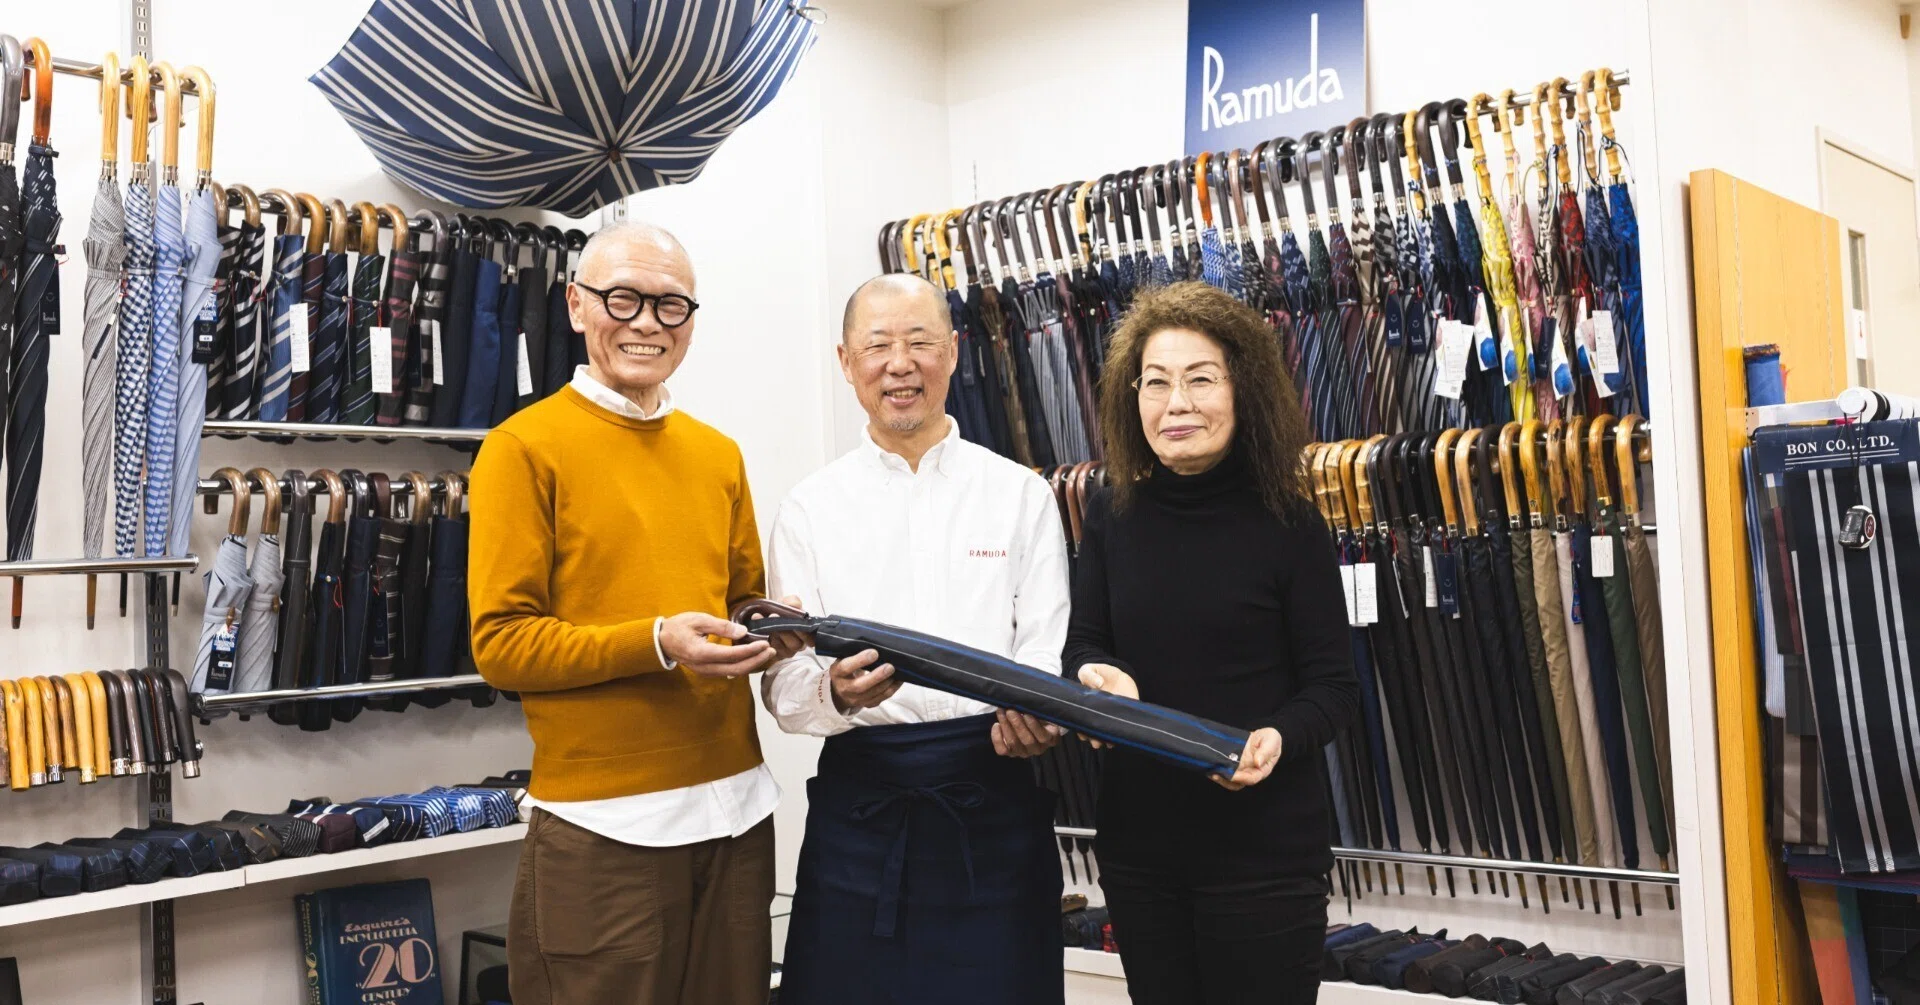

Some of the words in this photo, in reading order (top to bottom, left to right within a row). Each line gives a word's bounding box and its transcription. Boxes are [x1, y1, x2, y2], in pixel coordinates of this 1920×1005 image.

[1202, 13, 1344, 131] Ramuda
[1786, 442, 1818, 456] BON
[969, 549, 1006, 557] RAMUDA
[361, 987, 411, 1003] CENTURY
